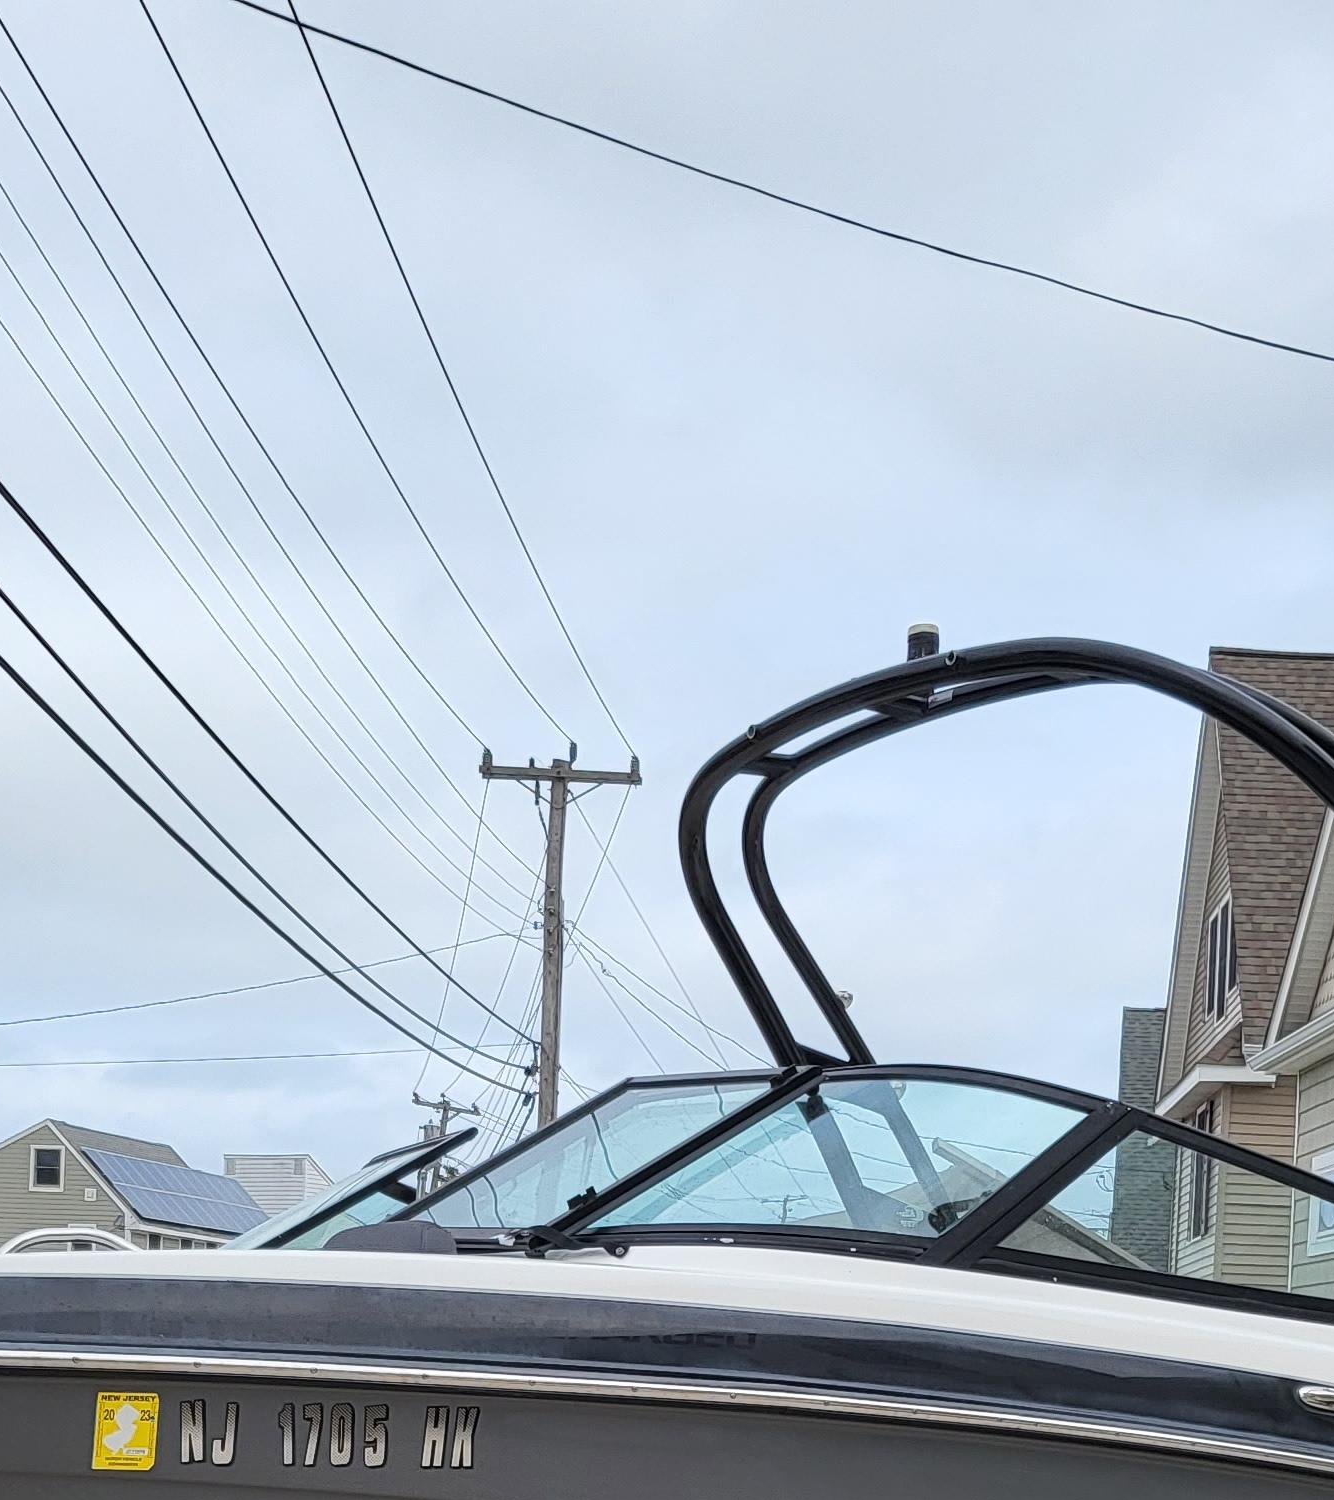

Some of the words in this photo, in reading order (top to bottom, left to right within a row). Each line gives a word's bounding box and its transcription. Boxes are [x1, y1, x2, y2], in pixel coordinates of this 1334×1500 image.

[101, 1394, 121, 1402] NEW
[122, 1394, 157, 1402] JERSEY
[103, 1408, 115, 1421] 20
[139, 1409, 151, 1421] 23
[180, 1400, 239, 1466] NJ
[278, 1402, 389, 1467] 1705
[420, 1405, 480, 1470] HK
